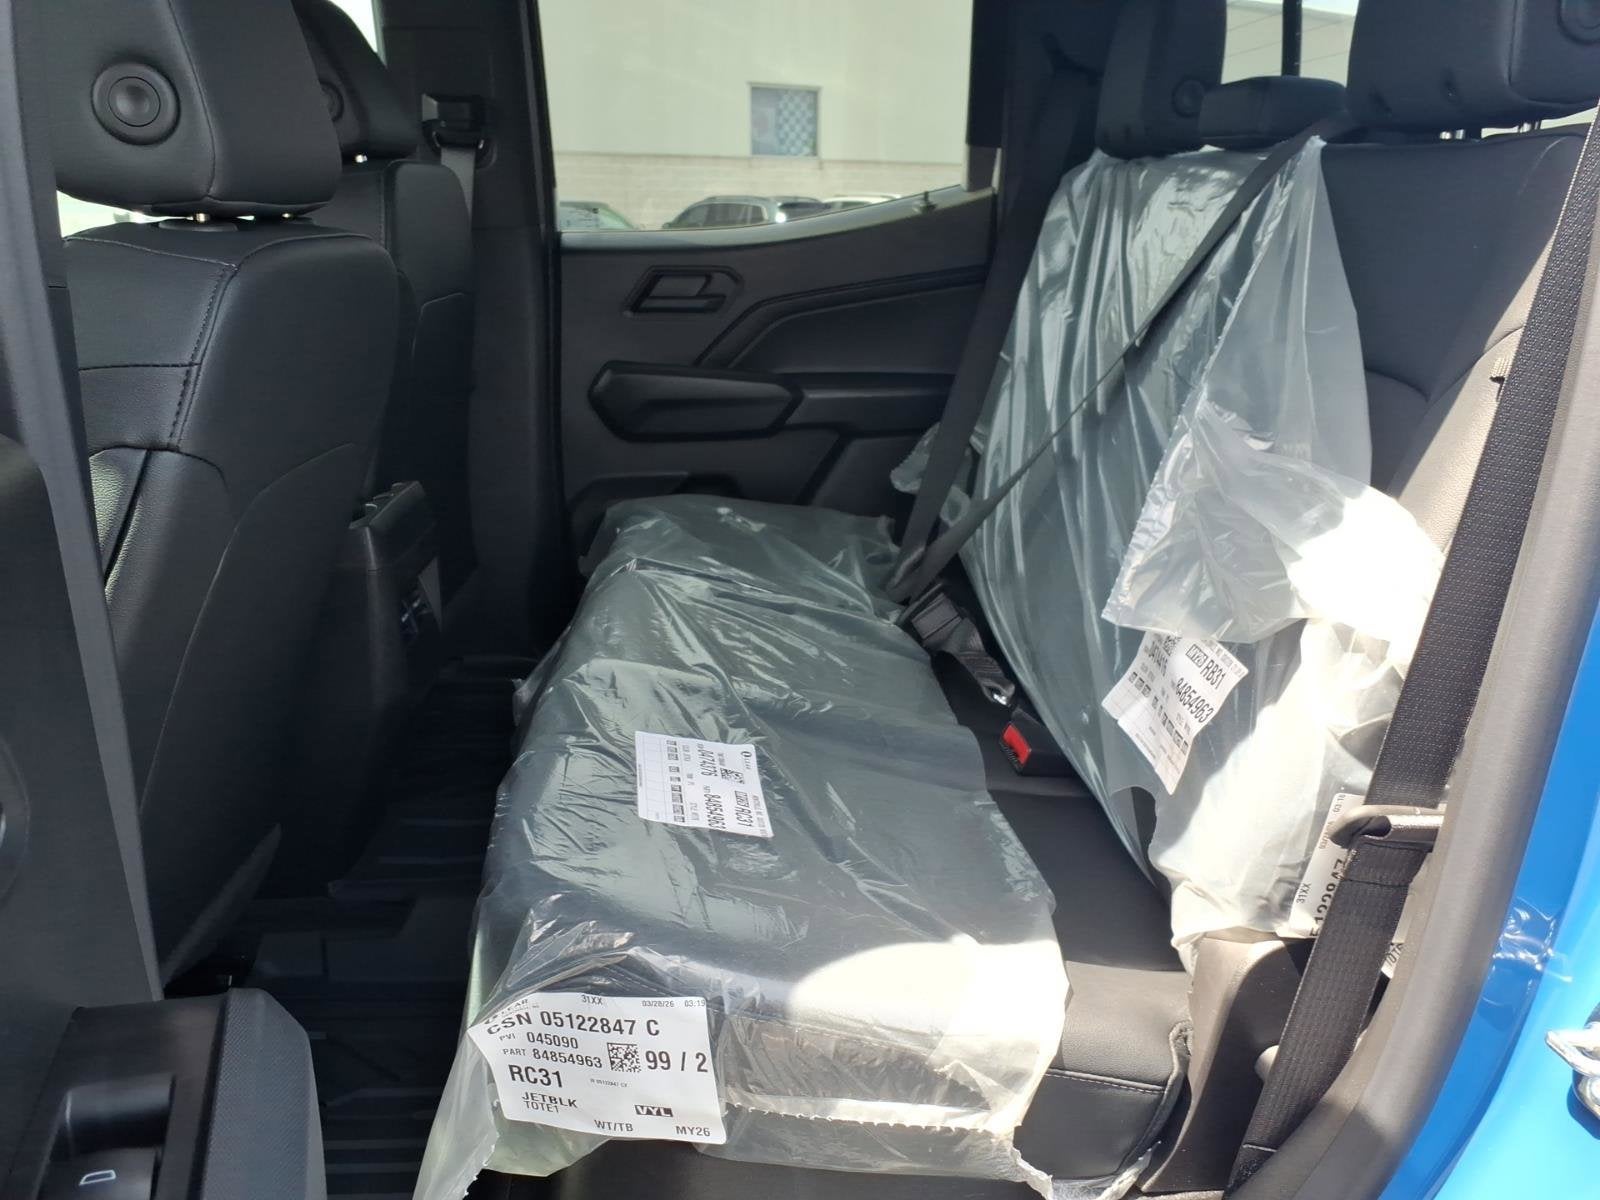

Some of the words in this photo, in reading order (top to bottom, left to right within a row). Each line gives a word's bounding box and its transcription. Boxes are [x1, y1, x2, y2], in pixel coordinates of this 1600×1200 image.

[1201, 660, 1227, 690] RB31
[1175, 677, 1214, 723] 84854963
[735, 805, 754, 828] RC31
[1296, 883, 1311, 904] 31XX
[581, 994, 603, 1005] 31XX
[684, 1000, 706, 1008] 03:19
[487, 1012, 532, 1035] CSN
[540, 1011, 636, 1036] 05122847
[646, 1019, 660, 1036] C
[499, 1033, 515, 1041] PVI
[526, 1031, 579, 1049] 045090
[503, 1048, 526, 1057] PART
[532, 1048, 603, 1068] 84854963
[645, 1051, 671, 1070] 99
[680, 1051, 687, 1071] /
[695, 1052, 708, 1073] 2
[508, 1064, 563, 1089] RC31
[521, 1091, 578, 1109] JETBLK
[524, 1100, 560, 1113] TOTE1
[635, 1104, 674, 1118] VYL
[594, 1119, 634, 1132] WT/TB
[676, 1125, 711, 1137] MY26
